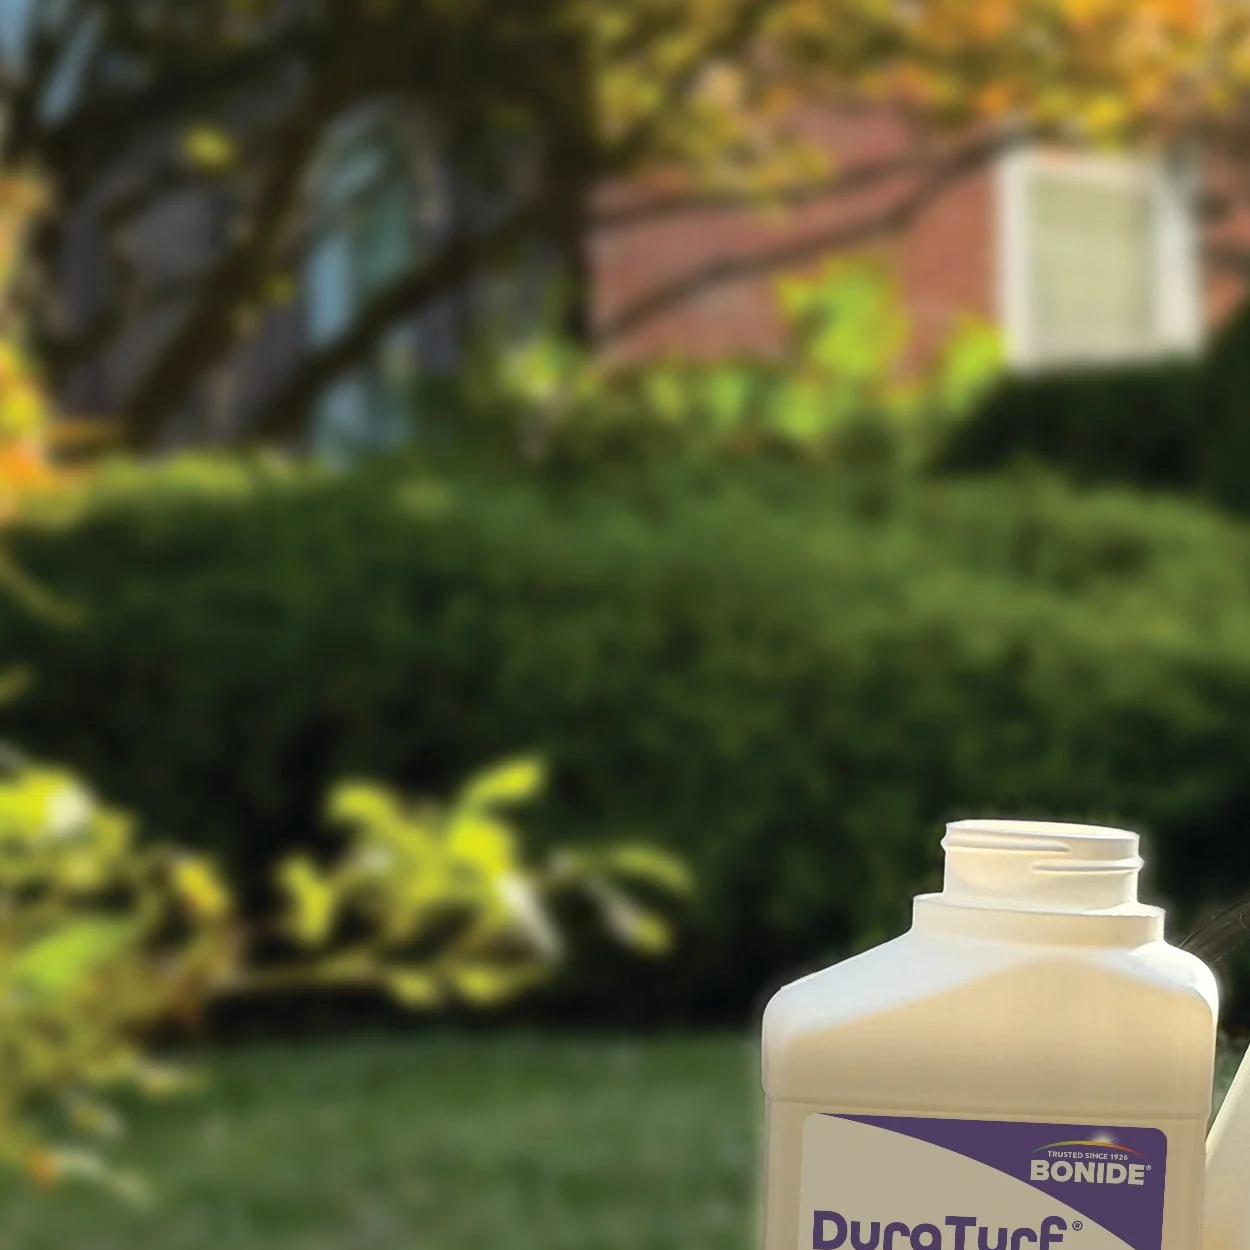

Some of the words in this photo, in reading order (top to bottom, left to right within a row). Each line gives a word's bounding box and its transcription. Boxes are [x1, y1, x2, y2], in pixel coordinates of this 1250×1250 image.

[1047, 1150, 1083, 1160] TRUSTED
[1084, 1151, 1108, 1161] SINCE
[1110, 1153, 1128, 1162] 1926
